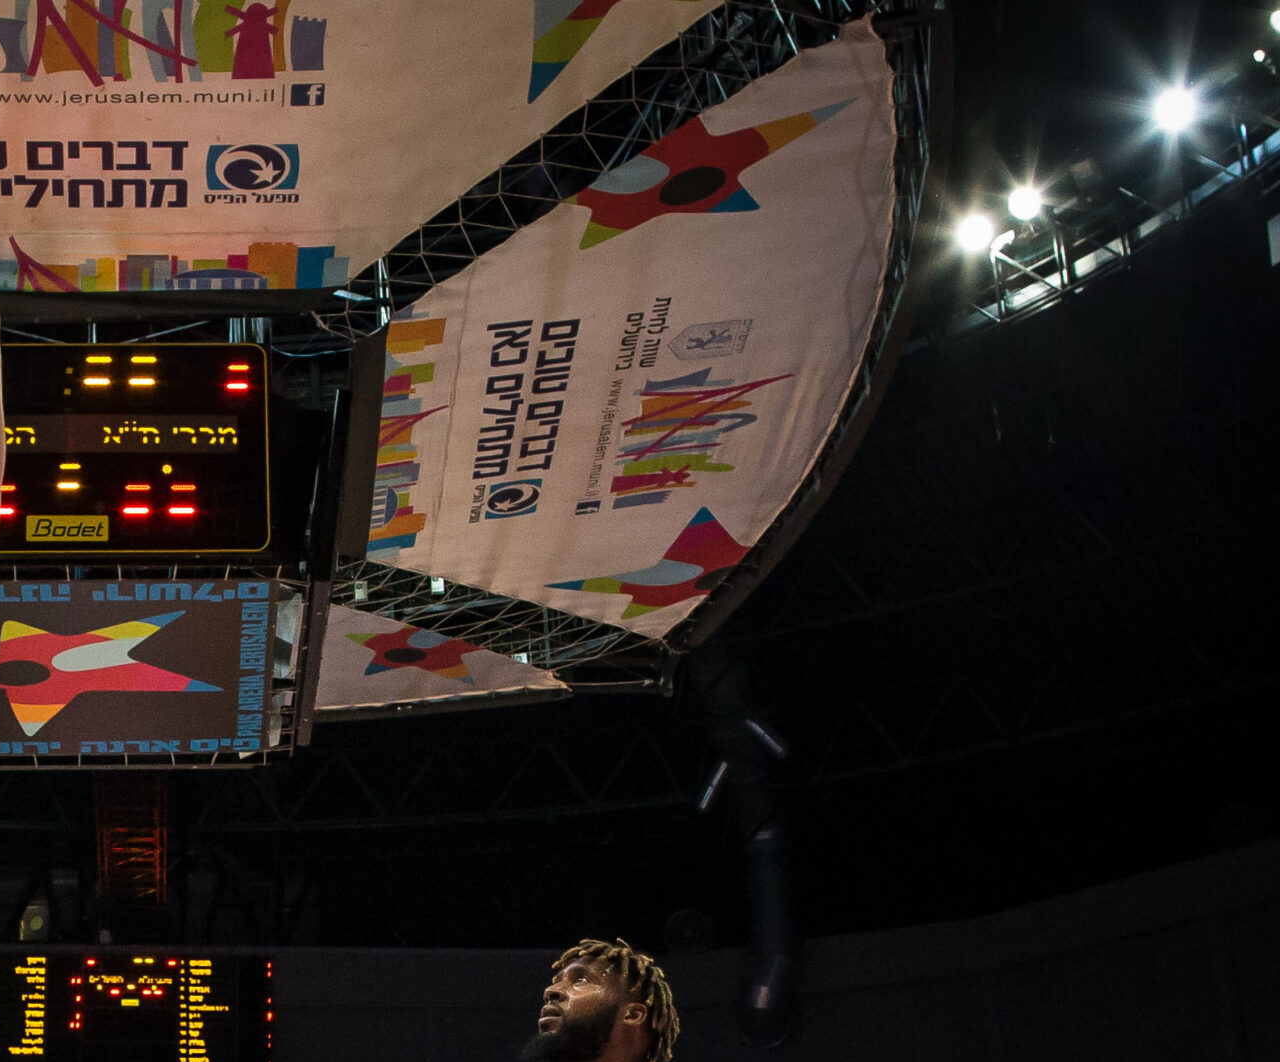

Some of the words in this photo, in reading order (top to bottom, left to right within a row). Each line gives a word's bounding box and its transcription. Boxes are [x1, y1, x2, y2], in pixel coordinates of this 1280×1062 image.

[26, 140, 190, 172] דברים
[204, 193, 248, 205] הפיס
[251, 190, 300, 204] מפעל
[487, 319, 533, 368] כאן
[532, 318, 581, 394] טובים
[472, 372, 525, 480] מתחילים
[517, 399, 565, 471] דברים
[32, 518, 104, 539] Bodet
[92, 581, 270, 603] ירושלים
[240, 601, 269, 671] JERUSALEM
[81, 739, 181, 753] ארנה
